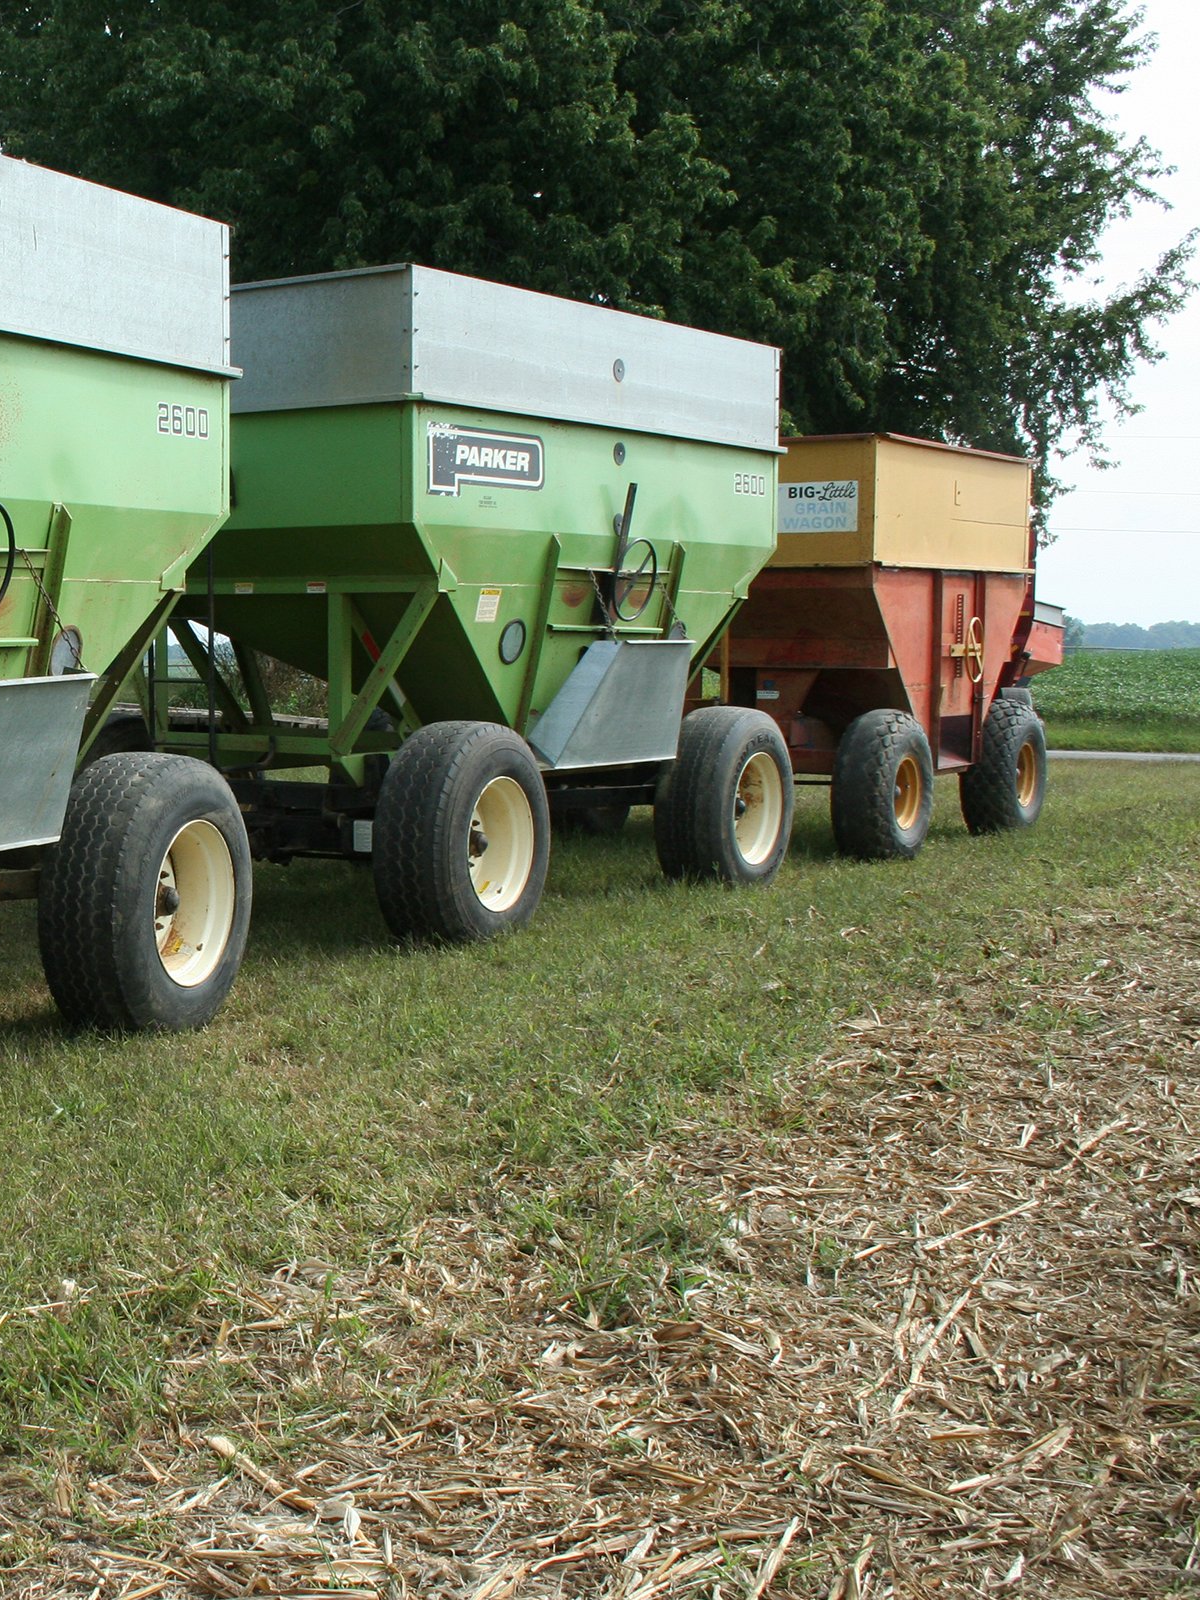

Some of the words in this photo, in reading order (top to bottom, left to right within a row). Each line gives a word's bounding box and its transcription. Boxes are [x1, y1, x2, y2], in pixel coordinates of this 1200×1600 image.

[157, 402, 210, 440] 2600
[456, 445, 530, 471] PARKER
[734, 472, 766, 497] 2600
[795, 501, 847, 515] GRAIN
[783, 516, 847, 529] WAGON
